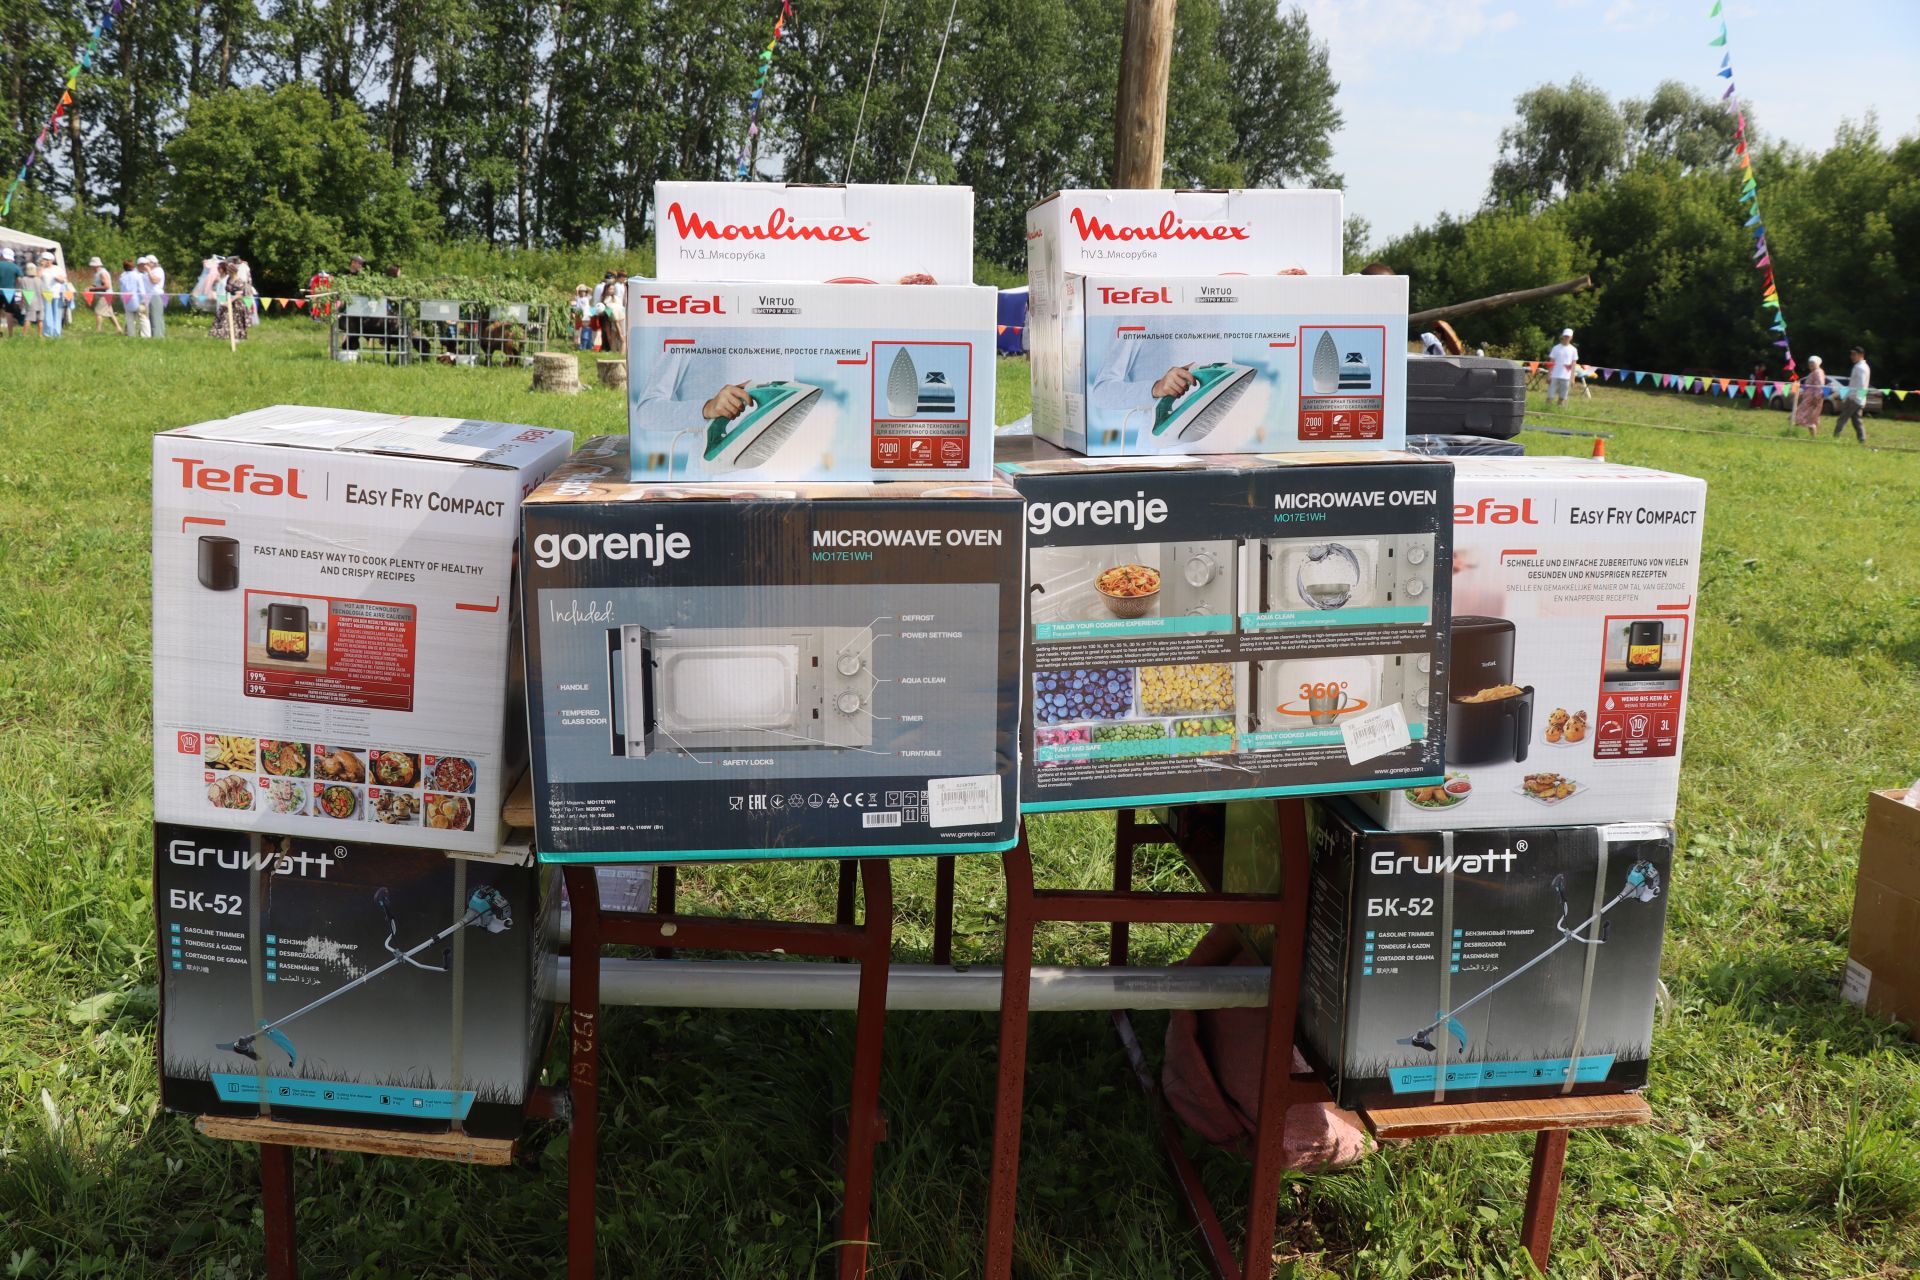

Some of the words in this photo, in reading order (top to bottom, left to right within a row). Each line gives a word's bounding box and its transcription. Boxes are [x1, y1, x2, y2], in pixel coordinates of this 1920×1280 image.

[668, 202, 870, 241] Moulinex
[1070, 207, 1250, 241] Moulinex
[1097, 287, 1173, 305] Tefal
[1201, 286, 1232, 295] VIRTUO
[641, 295, 726, 314] Tefal
[759, 296, 794, 306] VIRTUO
[670, 347, 727, 355] ОПТИМАЛЬНОЕ
[728, 347, 783, 356] СКОЛЬЖЕНИЕ,
[819, 348, 861, 356] ГЛАЖЕНИЕ
[1305, 417, 1322, 426] 2000
[880, 443, 898, 453] 2000
[172, 457, 308, 500] Tefal
[346, 483, 388, 506] EASY
[391, 488, 424, 510] FRY
[428, 491, 505, 518] COMPACT
[1274, 492, 1385, 510] MICROWAVE
[1389, 490, 1437, 506] OVEN
[1027, 490, 1168, 534] gorenje
[1274, 512, 1326, 522] MO17E1WH
[1453, 498, 1538, 525] efal
[1570, 507, 1604, 525] EASY
[1607, 507, 1633, 525] FRY
[1636, 507, 1697, 525] COMPACT
[534, 524, 691, 568] gorenje
[812, 529, 942, 547] MICROWAVE
[946, 529, 1003, 546] OVEN
[253, 545, 277, 556] FAST
[278, 547, 298, 558] AND
[300, 549, 324, 561] EASY
[325, 552, 347, 563] WAY
[348, 554, 361, 564] TO
[362, 556, 387, 567] COOK
[389, 558, 425, 570] PLENTY
[427, 560, 439, 571] OF
[441, 562, 484, 576] HEALTHY
[812, 551, 873, 562] MO17E1WH
[1506, 559, 1545, 567] SCHNELLE
[1546, 559, 1561, 567] UND
[1562, 559, 1598, 567] EINFACHE
[1599, 559, 1647, 567] ZUBEREITUNG
[1649, 558, 1663, 566] VON
[1664, 558, 1689, 566] VIELEN
[320, 565, 340, 576] AND
[341, 567, 375, 579] CRISPY
[376, 570, 415, 582] RECIPES
[1527, 571, 1567, 579] GESUNDEN
[1585, 570, 1630, 578] KNUSPRIGEN
[1632, 570, 1668, 578] REZEPTEN
[1593, 583, 1618, 591] MANIER
[1656, 582, 1686, 590] GEZONDE
[1299, 681, 1348, 700] 360°
[1660, 719, 1670, 730] 3L
[750, 758, 774, 766] LOCKS
[940, 830, 995, 838] www.gorenje.com
[169, 839, 334, 879] Gruwatt
[1370, 848, 1517, 875] Gruwatt
[169, 887, 242, 916] БК-52
[1367, 897, 1434, 917] БК-52
[184, 926, 215, 936] GASOLINE
[215, 930, 245, 939] TRIMMER
[184, 939, 215, 949] TONDEUSE
[185, 952, 216, 961] CORTADOR
[225, 957, 248, 965] GRAMA
